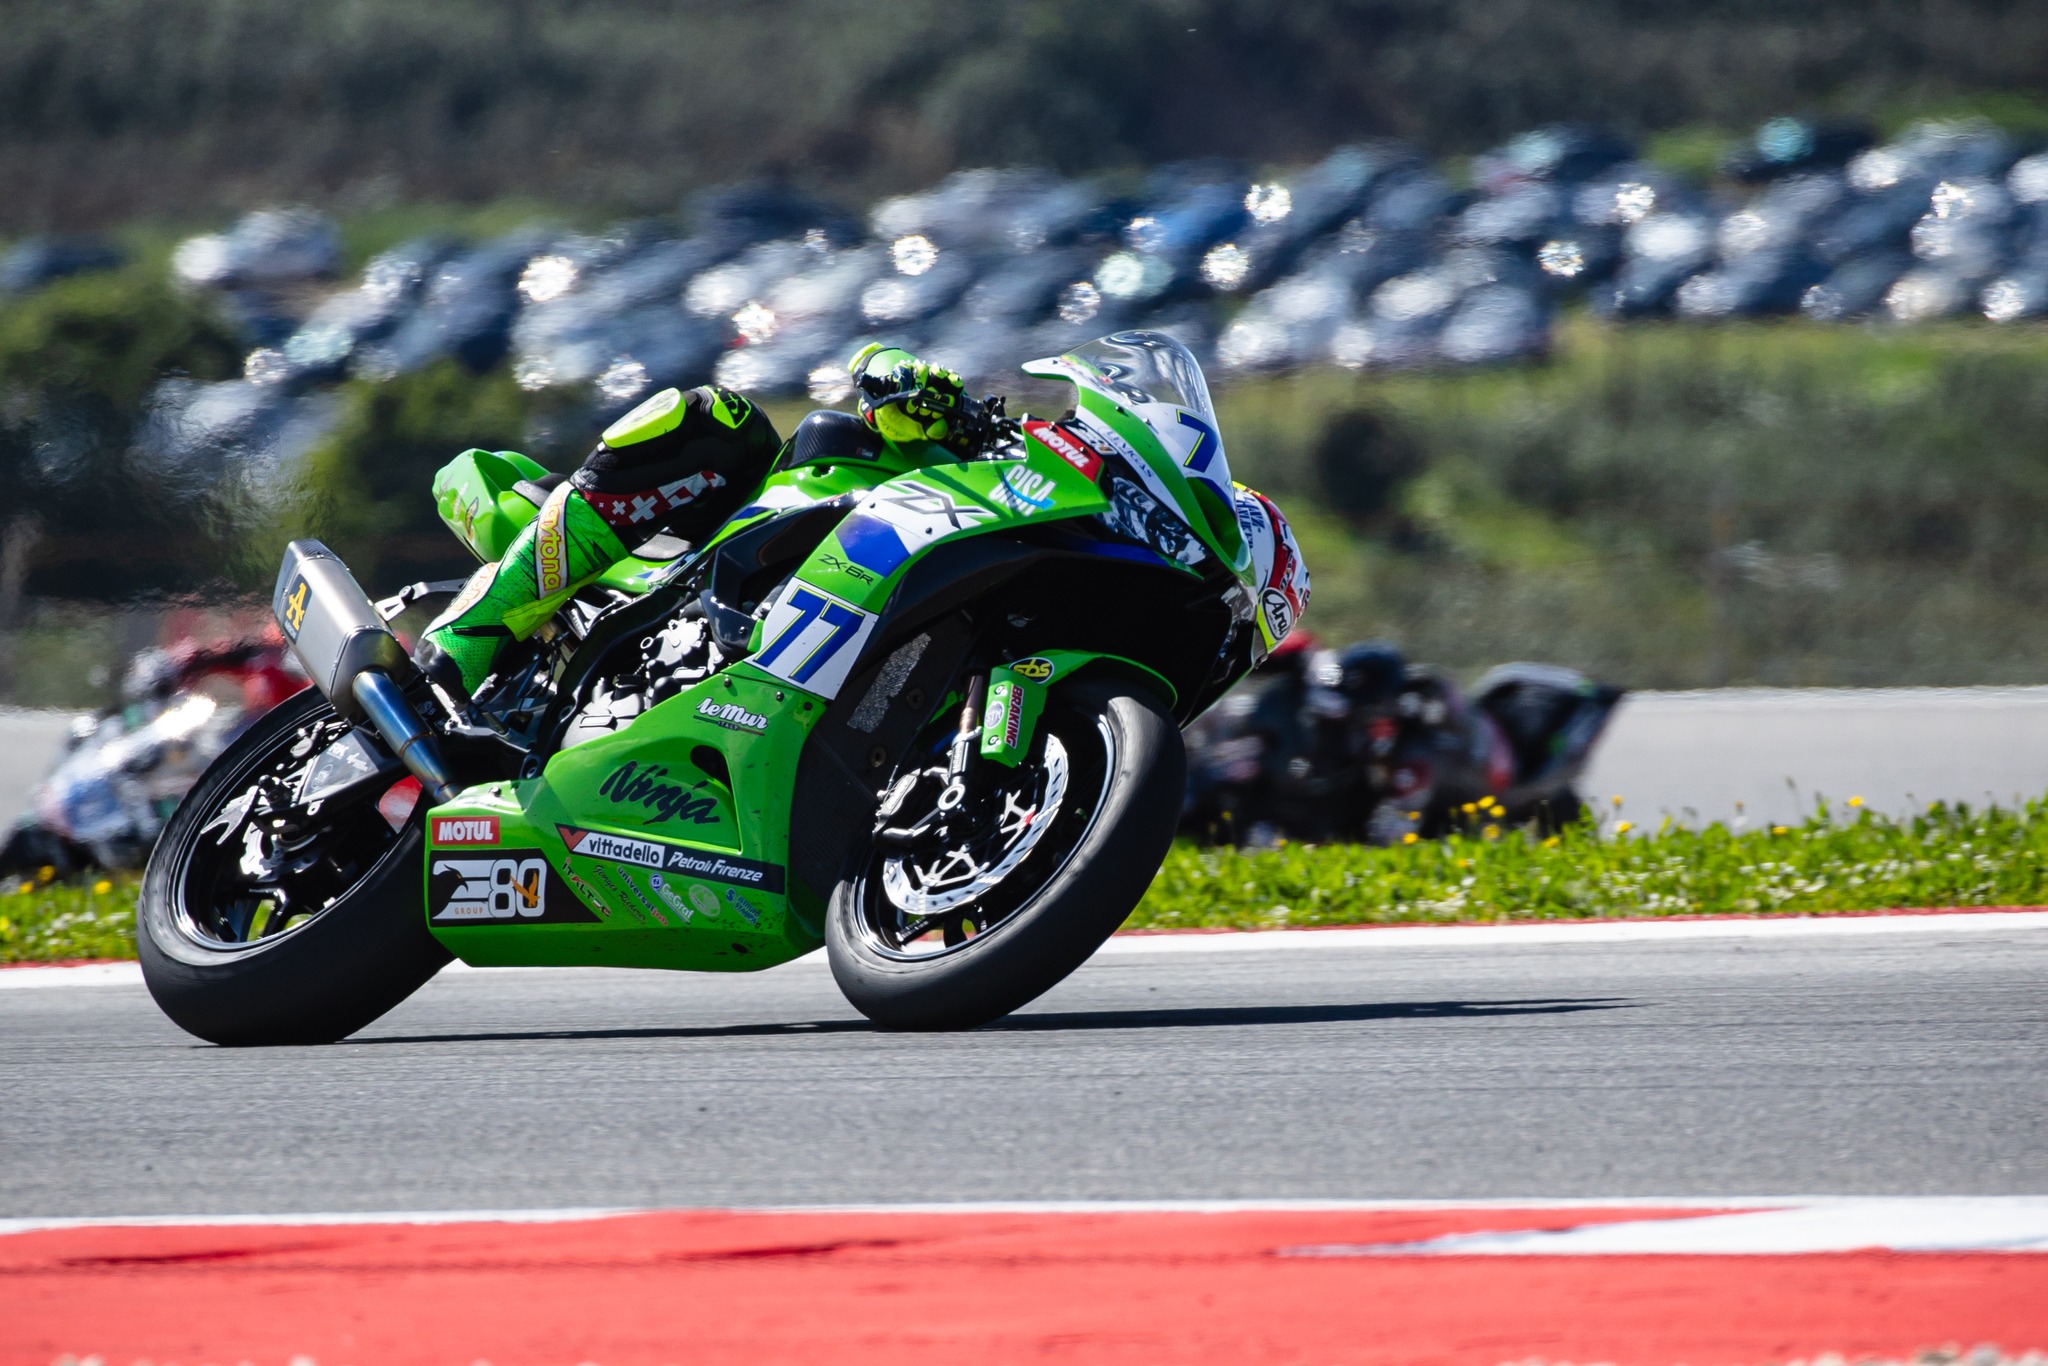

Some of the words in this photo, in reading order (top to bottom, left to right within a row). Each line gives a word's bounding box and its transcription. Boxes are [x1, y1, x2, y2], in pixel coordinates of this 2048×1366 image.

[1033, 427, 1088, 468] MOTUL
[1176, 409, 1218, 473] 7
[818, 553, 874, 586] ZX-6R
[1264, 599, 1288, 635] Arai
[753, 585, 865, 684] 77
[1013, 658, 1051, 677] sbs
[718, 721, 738, 731] ITALY
[1005, 685, 1024, 749] BRAKING
[599, 760, 720, 825] Ninja
[438, 821, 493, 841] MOTUL
[588, 837, 660, 864] vittadello
[711, 859, 763, 881] Firenze
[454, 907, 484, 915] GROUP
